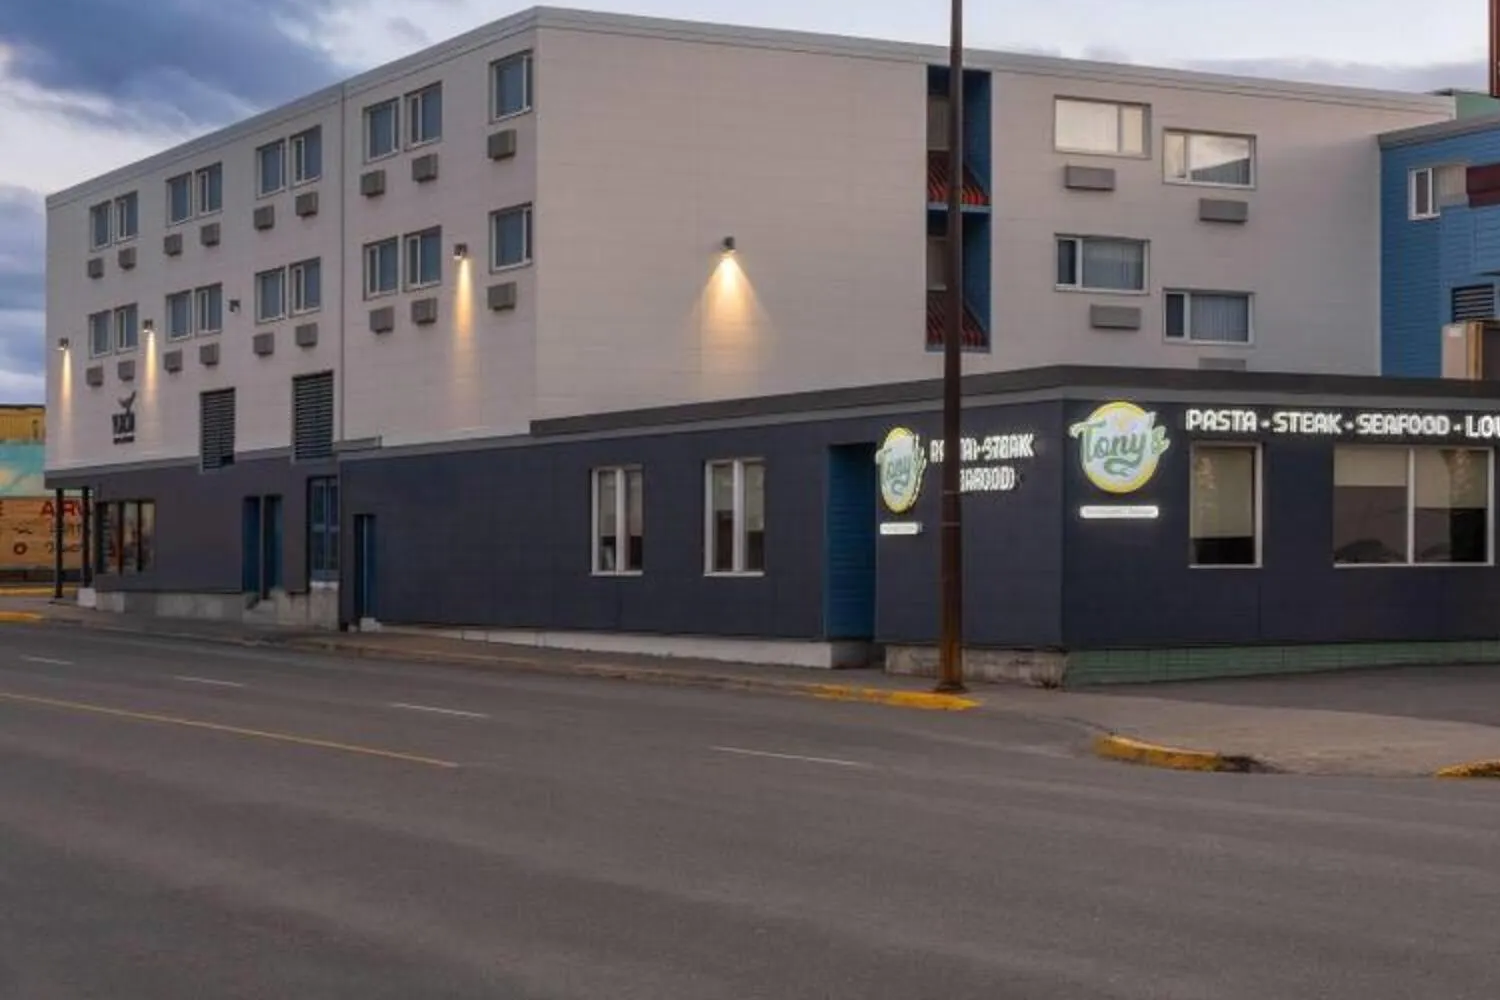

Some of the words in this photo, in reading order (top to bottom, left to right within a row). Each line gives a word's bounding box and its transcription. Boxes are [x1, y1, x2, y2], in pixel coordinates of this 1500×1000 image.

[1068, 411, 1171, 477] Tony's
[1185, 408, 1257, 432] PASTA
[1272, 411, 1342, 434] STEAK
[1355, 412, 1450, 435] SEAFOOD
